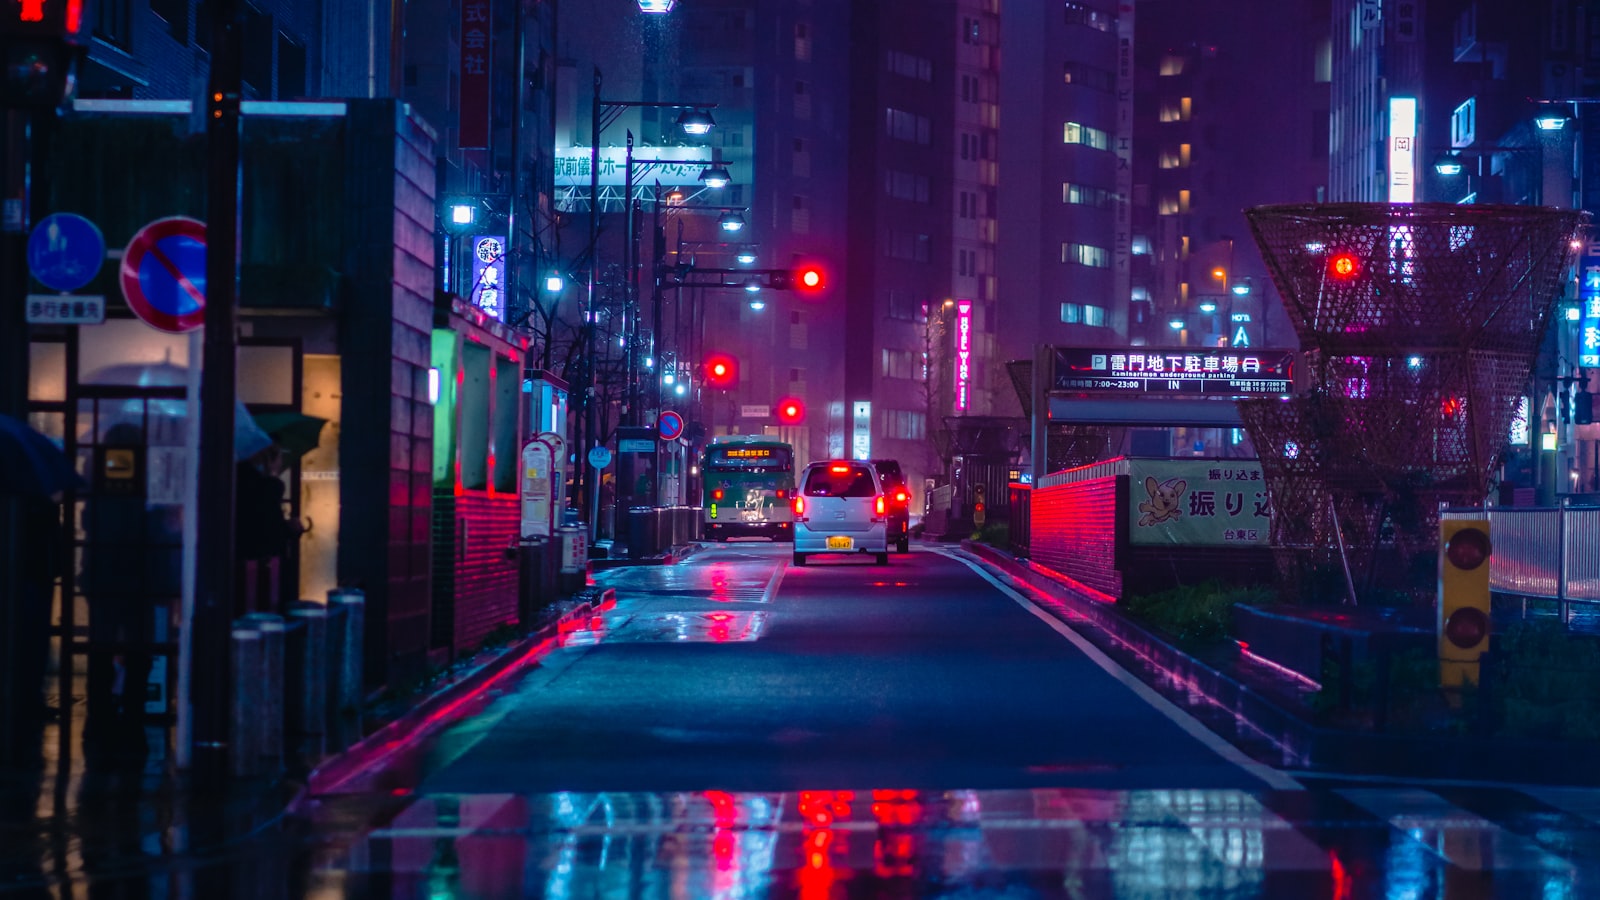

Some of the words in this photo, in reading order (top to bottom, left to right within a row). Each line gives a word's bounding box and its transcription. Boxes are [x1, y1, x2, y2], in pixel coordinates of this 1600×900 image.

[31, 302, 98, 318] 歩行者優先
[1111, 355, 1238, 372] 雷門地下駐車場
[1160, 372, 1205, 380] underground
[1209, 372, 1236, 380] parking
[1168, 381, 1180, 389] IN
[1224, 530, 1258, 541] 台東区
